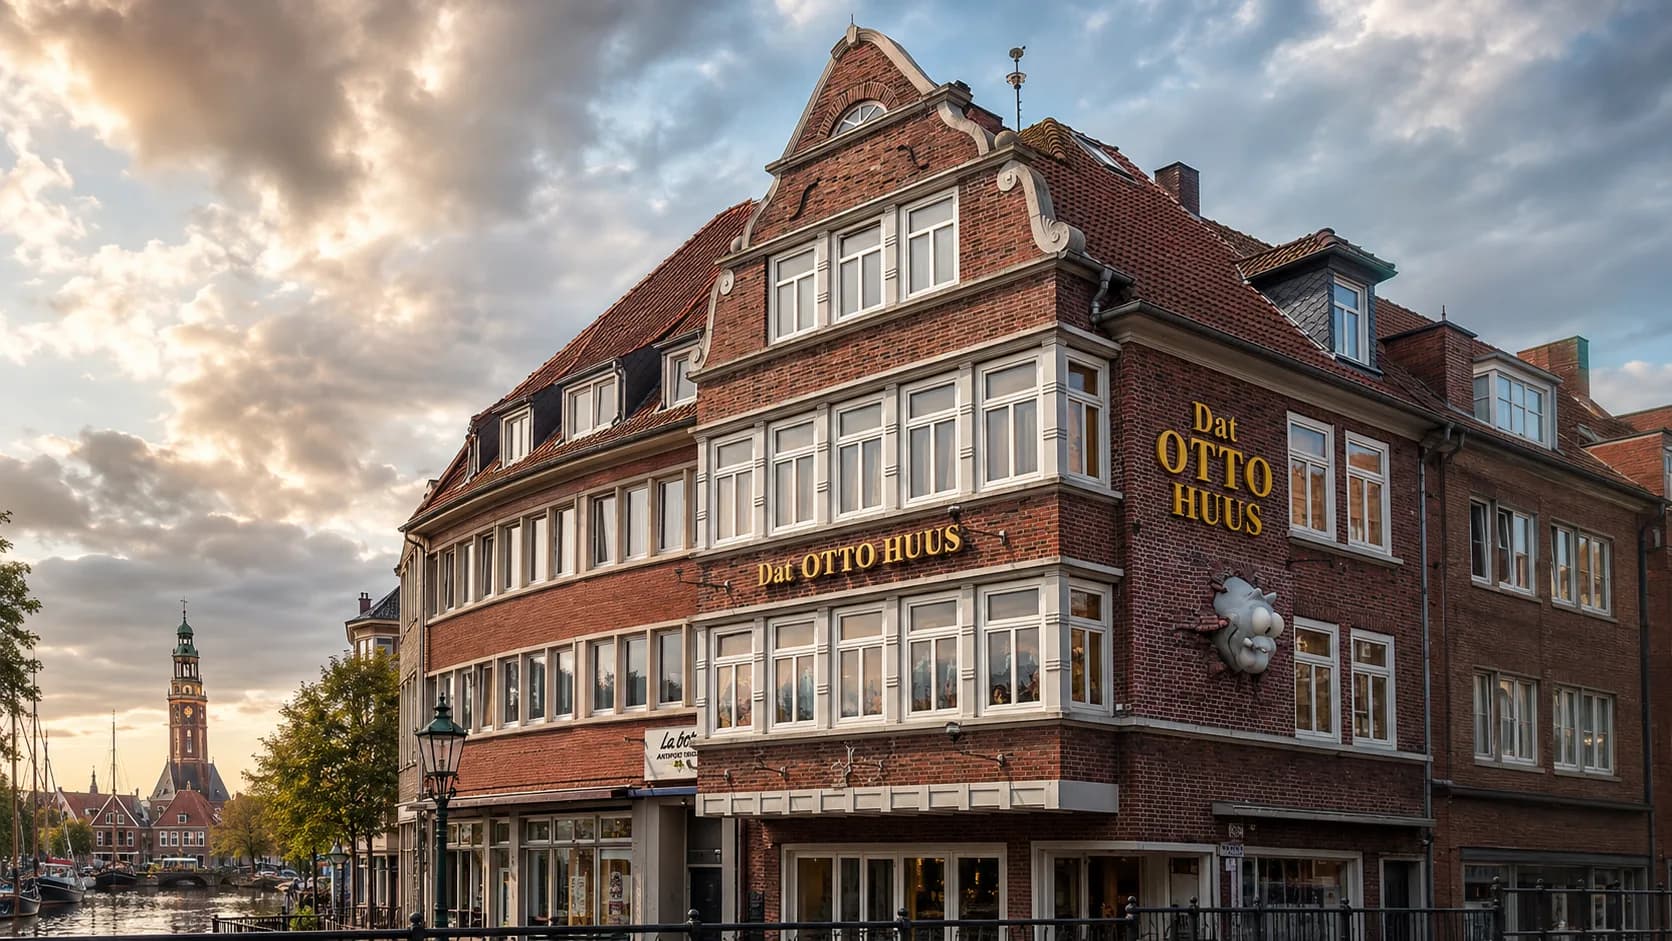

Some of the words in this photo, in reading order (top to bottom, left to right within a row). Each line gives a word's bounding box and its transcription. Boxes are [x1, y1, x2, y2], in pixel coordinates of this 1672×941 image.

[1192, 400, 1238, 442] Dat
[1156, 429, 1273, 498] OTTO
[1171, 482, 1263, 536] HUUS
[757, 559, 795, 586] Dat
[801, 542, 878, 579] OTTO
[882, 524, 964, 564] HUUS
[660, 731, 675, 749] La
